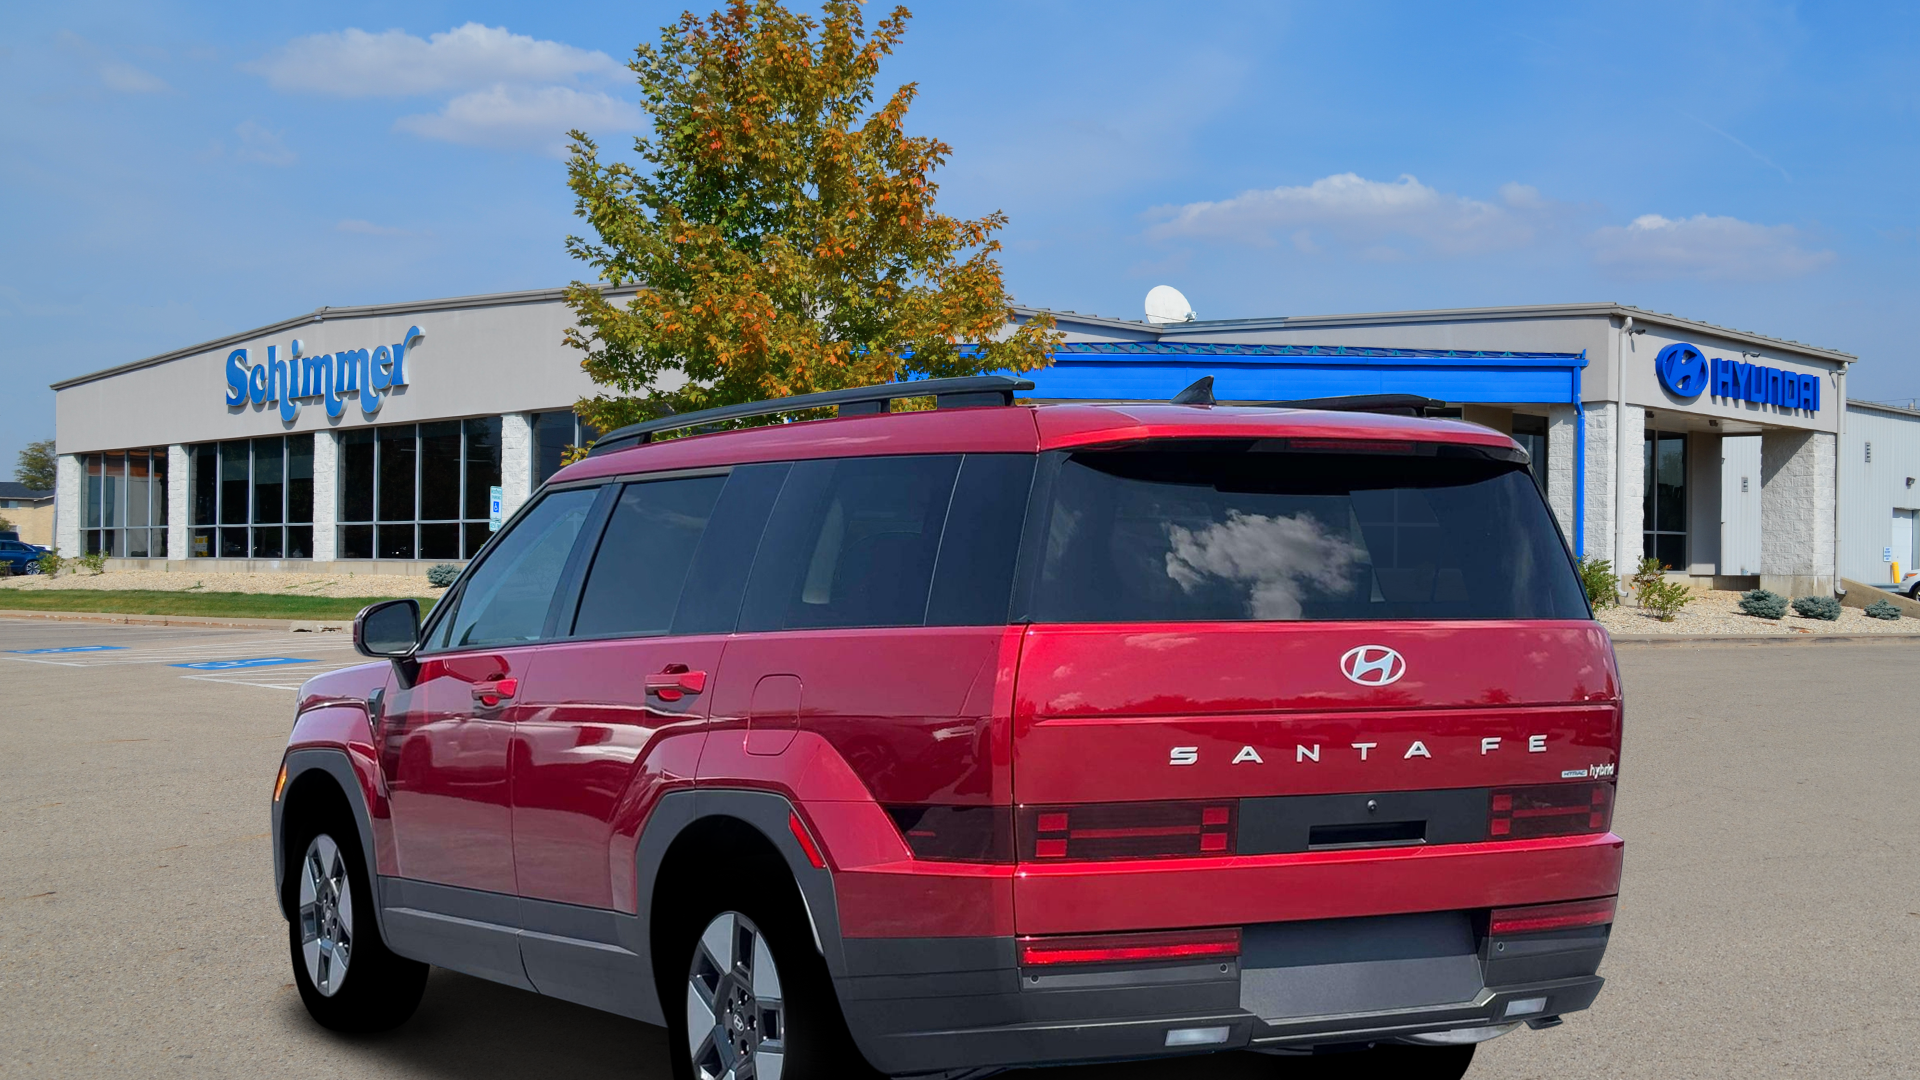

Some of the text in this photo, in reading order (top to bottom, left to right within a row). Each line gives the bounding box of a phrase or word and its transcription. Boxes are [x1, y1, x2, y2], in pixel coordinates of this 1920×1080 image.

[226, 325, 426, 422] Schimmer
[1711, 358, 1820, 411] HYUNDAI
[1169, 734, 1548, 766] SANTA FE
[1589, 762, 1615, 779] hybrid
